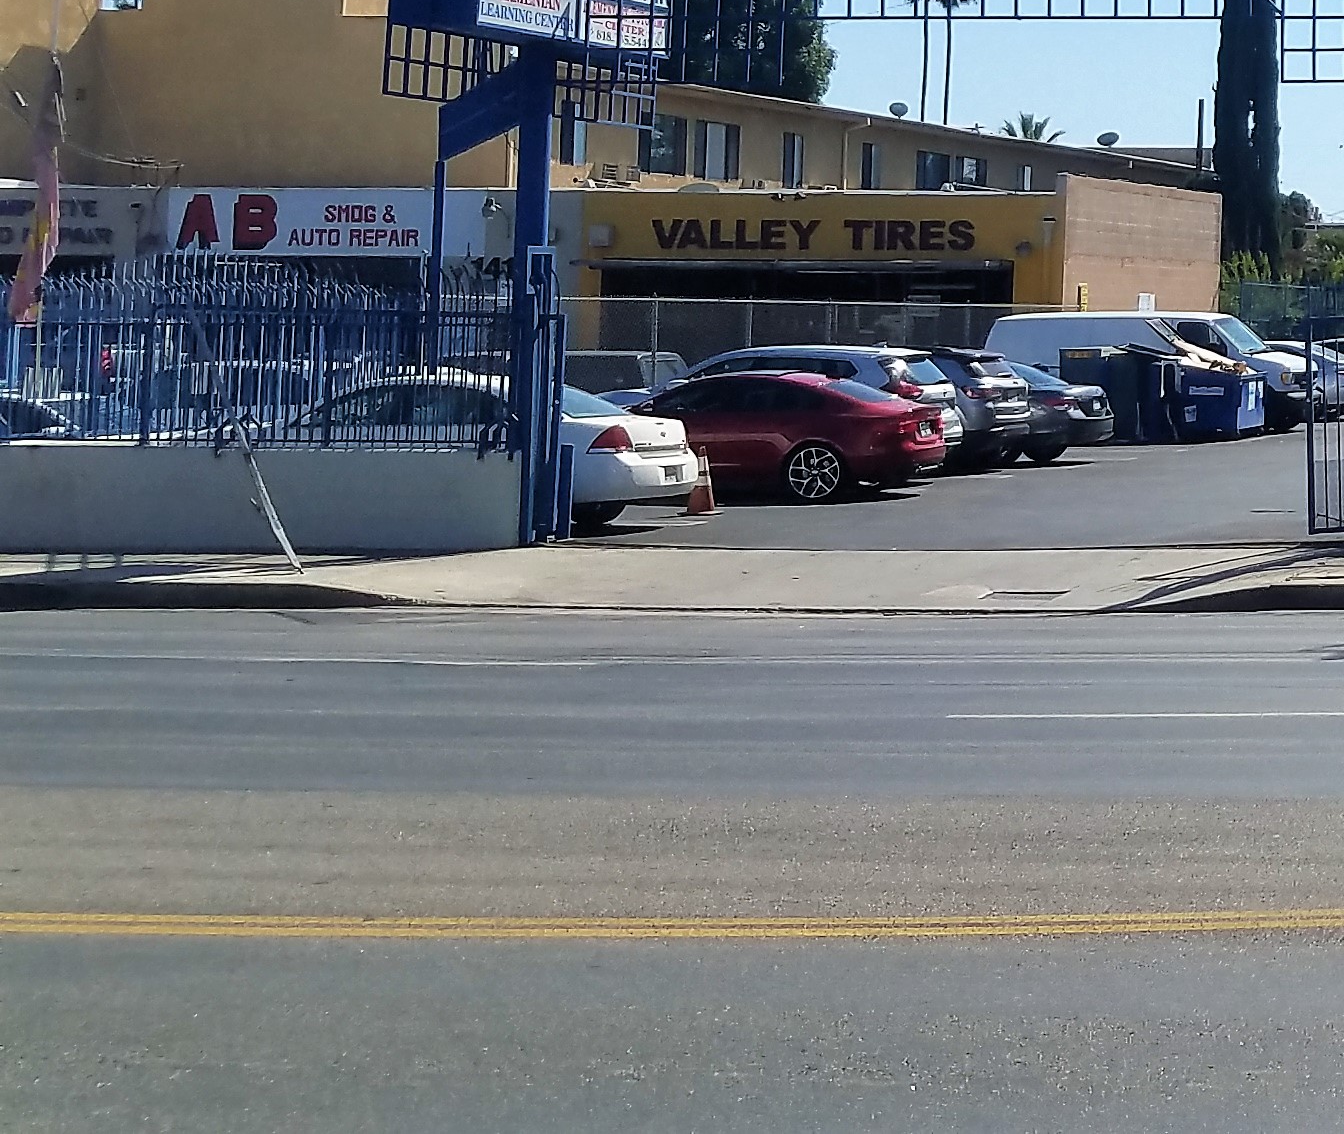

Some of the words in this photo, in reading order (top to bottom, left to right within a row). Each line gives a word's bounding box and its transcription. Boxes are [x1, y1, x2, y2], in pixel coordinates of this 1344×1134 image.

[481, 2, 533, 24] LEARNING
[324, 205, 376, 223] SMOG
[382, 205, 397, 224] &
[288, 229, 341, 247] AUTO
[350, 229, 419, 247] REPAIR
[652, 219, 821, 250] VALLEY
[844, 219, 976, 251] TIRES
